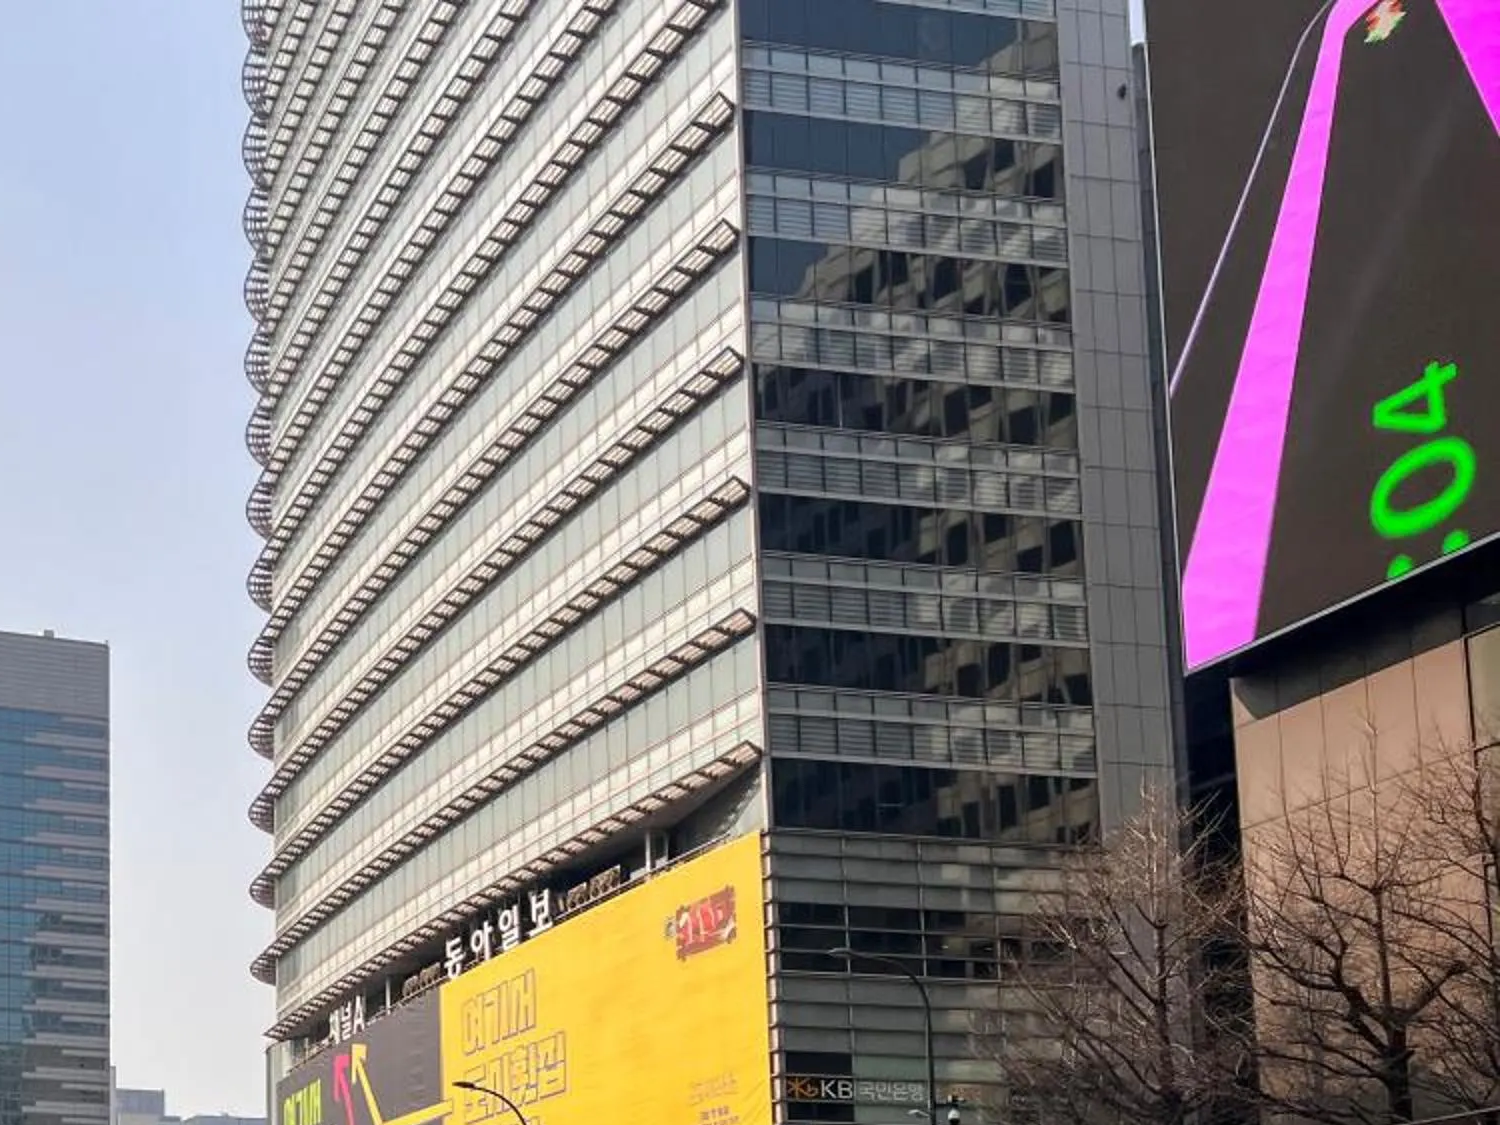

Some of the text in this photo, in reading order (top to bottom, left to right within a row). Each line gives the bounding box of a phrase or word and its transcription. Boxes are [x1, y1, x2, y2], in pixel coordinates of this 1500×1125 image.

[444, 888, 553, 979] 동아일보
[463, 967, 536, 1056] 여기서
[821, 1080, 853, 1099] KB
[860, 1081, 925, 1101] 국민은행
